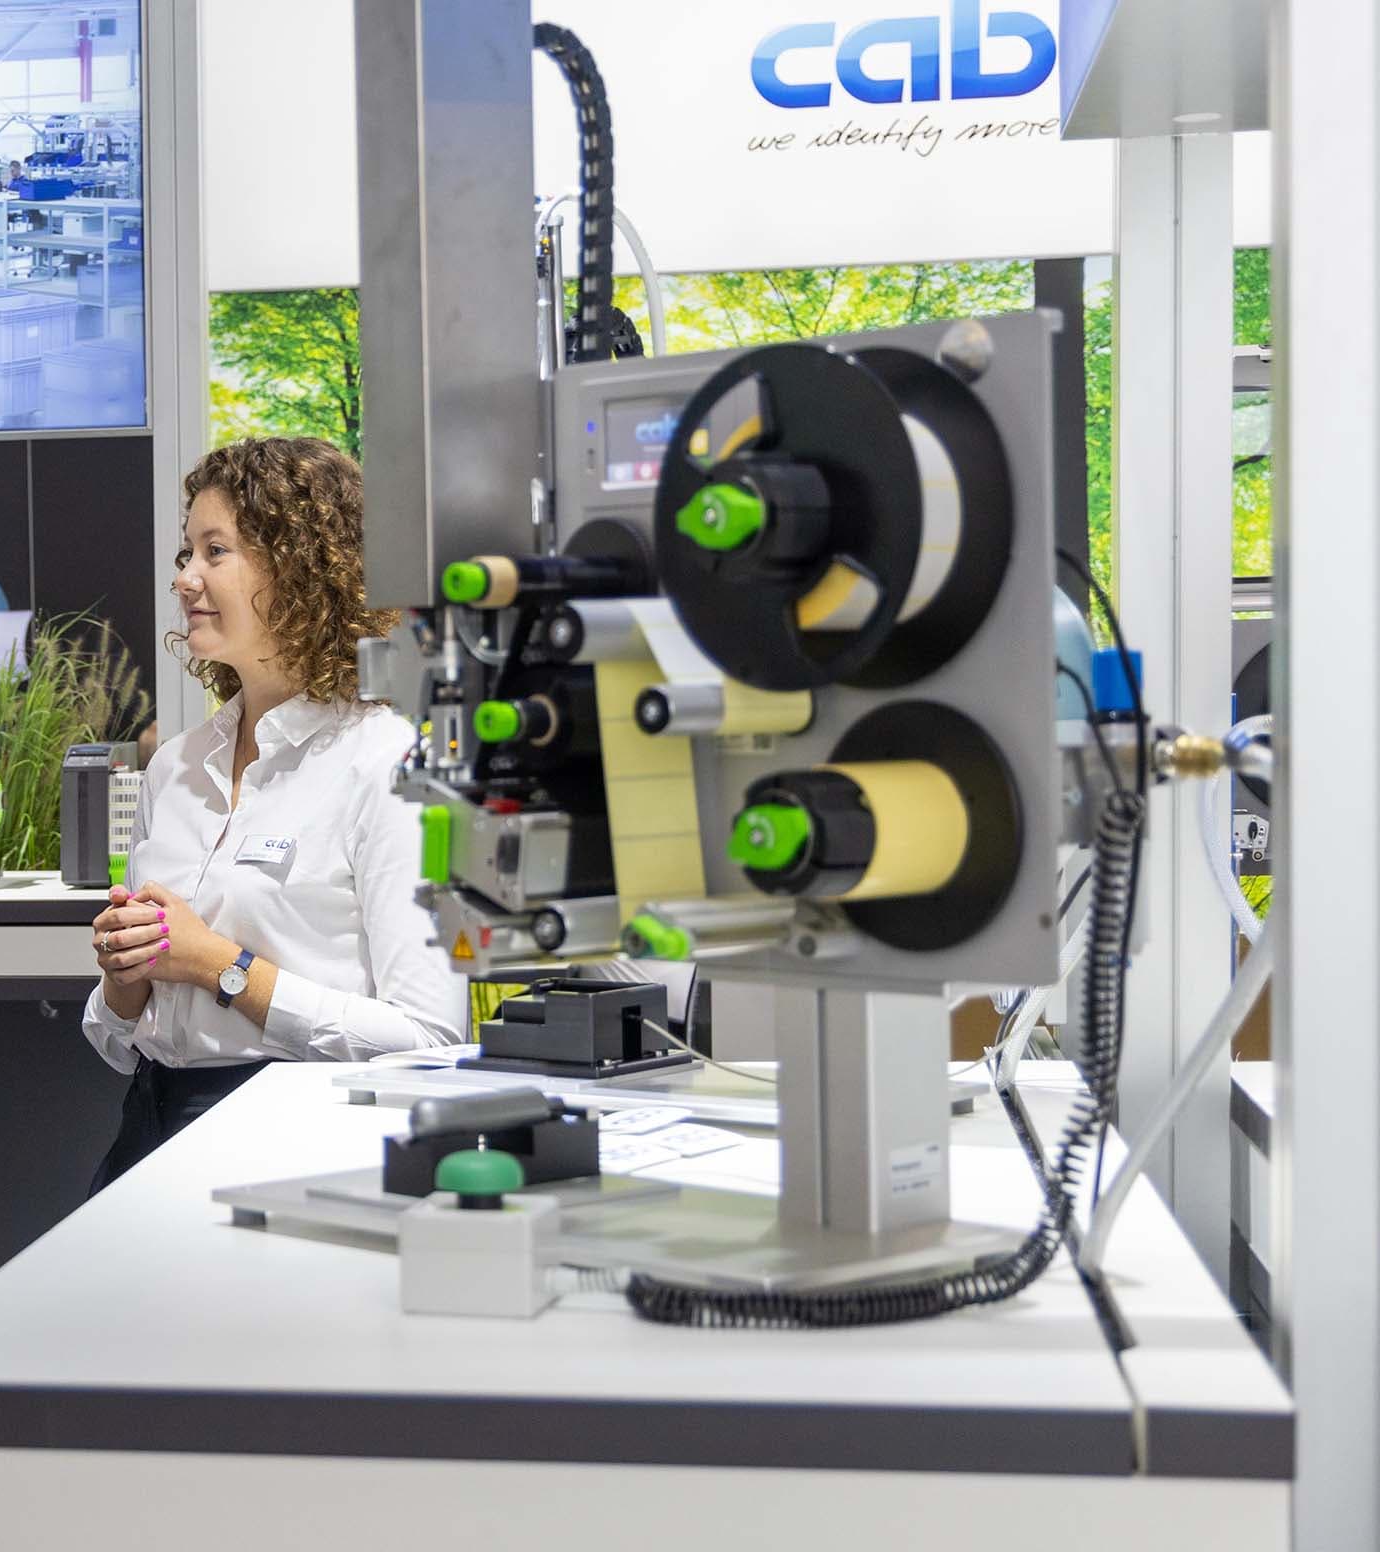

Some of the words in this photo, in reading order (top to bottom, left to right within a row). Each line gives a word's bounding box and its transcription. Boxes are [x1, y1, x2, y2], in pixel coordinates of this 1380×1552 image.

[750, 0, 1057, 109] cab
[747, 131, 796, 152] we
[805, 115, 943, 157] identify
[956, 117, 1060, 140] more
[265, 839, 290, 850] cab
